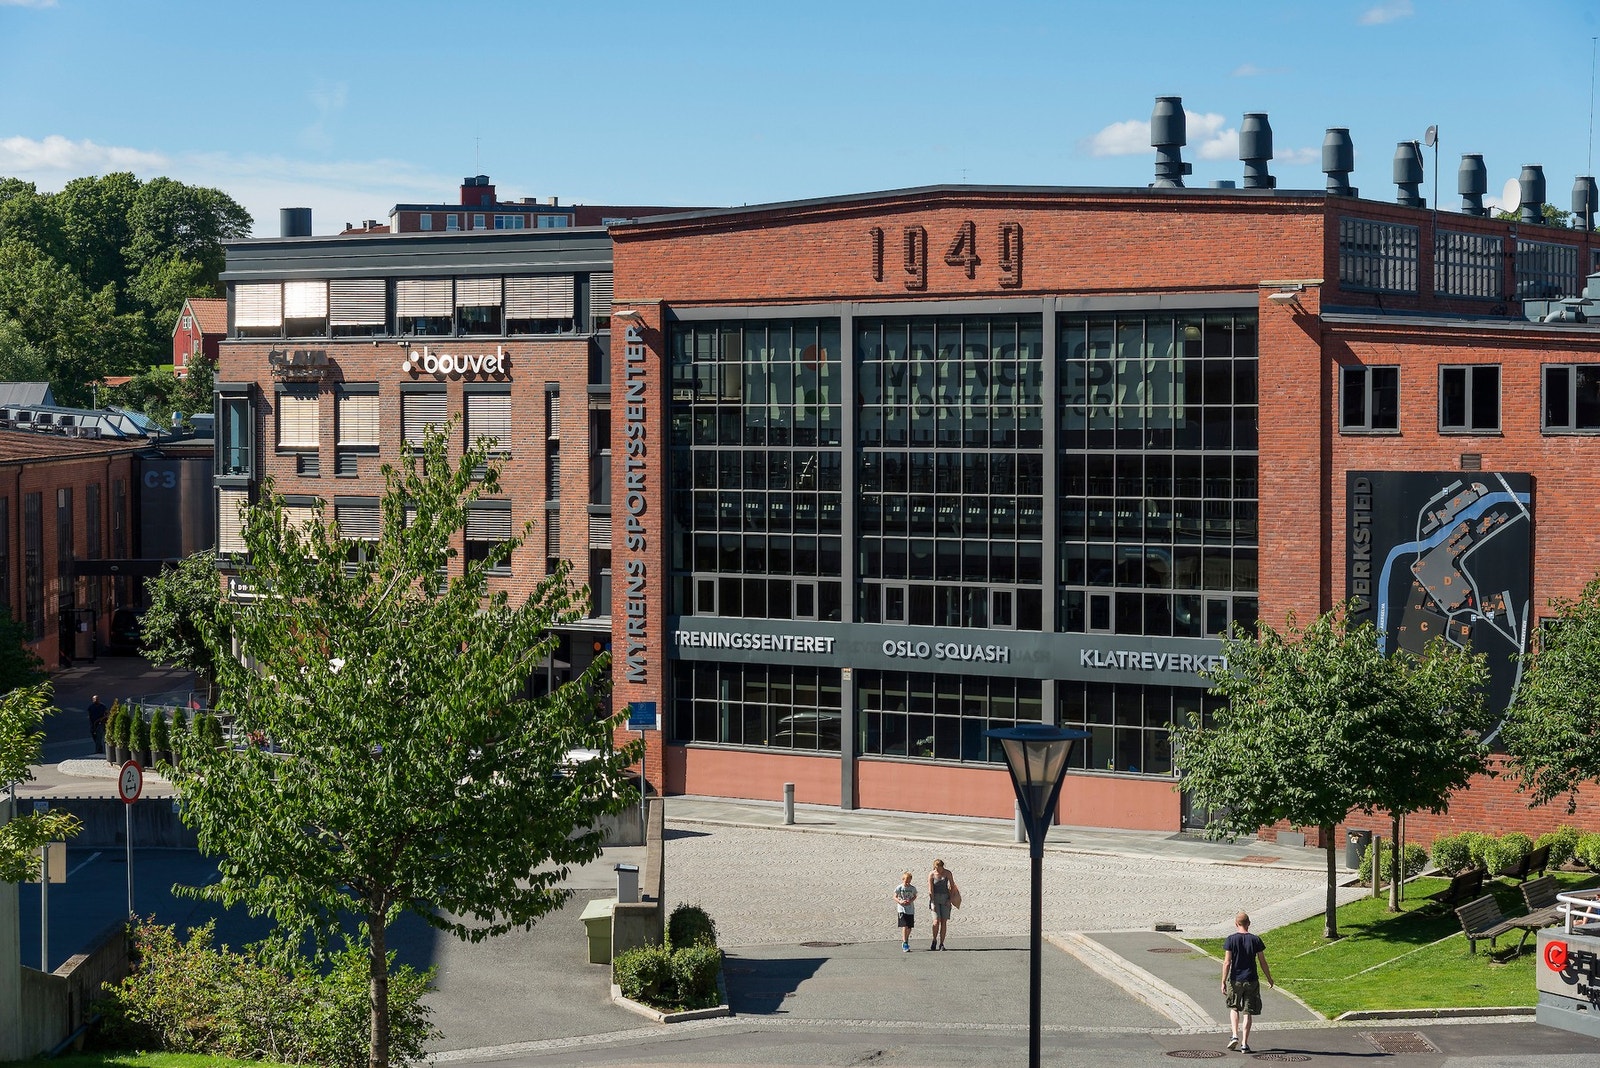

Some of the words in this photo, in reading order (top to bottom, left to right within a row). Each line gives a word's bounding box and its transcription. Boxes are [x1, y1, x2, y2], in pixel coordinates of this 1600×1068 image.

[869, 220, 1024, 291] 1949
[423, 345, 505, 374] bouvet
[625, 325, 646, 551] SPORTSSENTER
[144, 470, 177, 488] C3
[1353, 477, 1372, 614] VERKSTED
[1443, 576, 1452, 586] D
[1497, 601, 1505, 610] A
[625, 559, 646, 684] MYRENS
[1420, 622, 1428, 631] C
[1461, 626, 1469, 635] B
[672, 630, 835, 653] TRENINGSSENTERET
[882, 639, 930, 658] OSLO
[935, 643, 1009, 663] SQUASH
[1080, 649, 1227, 672] KLATREVERKET
